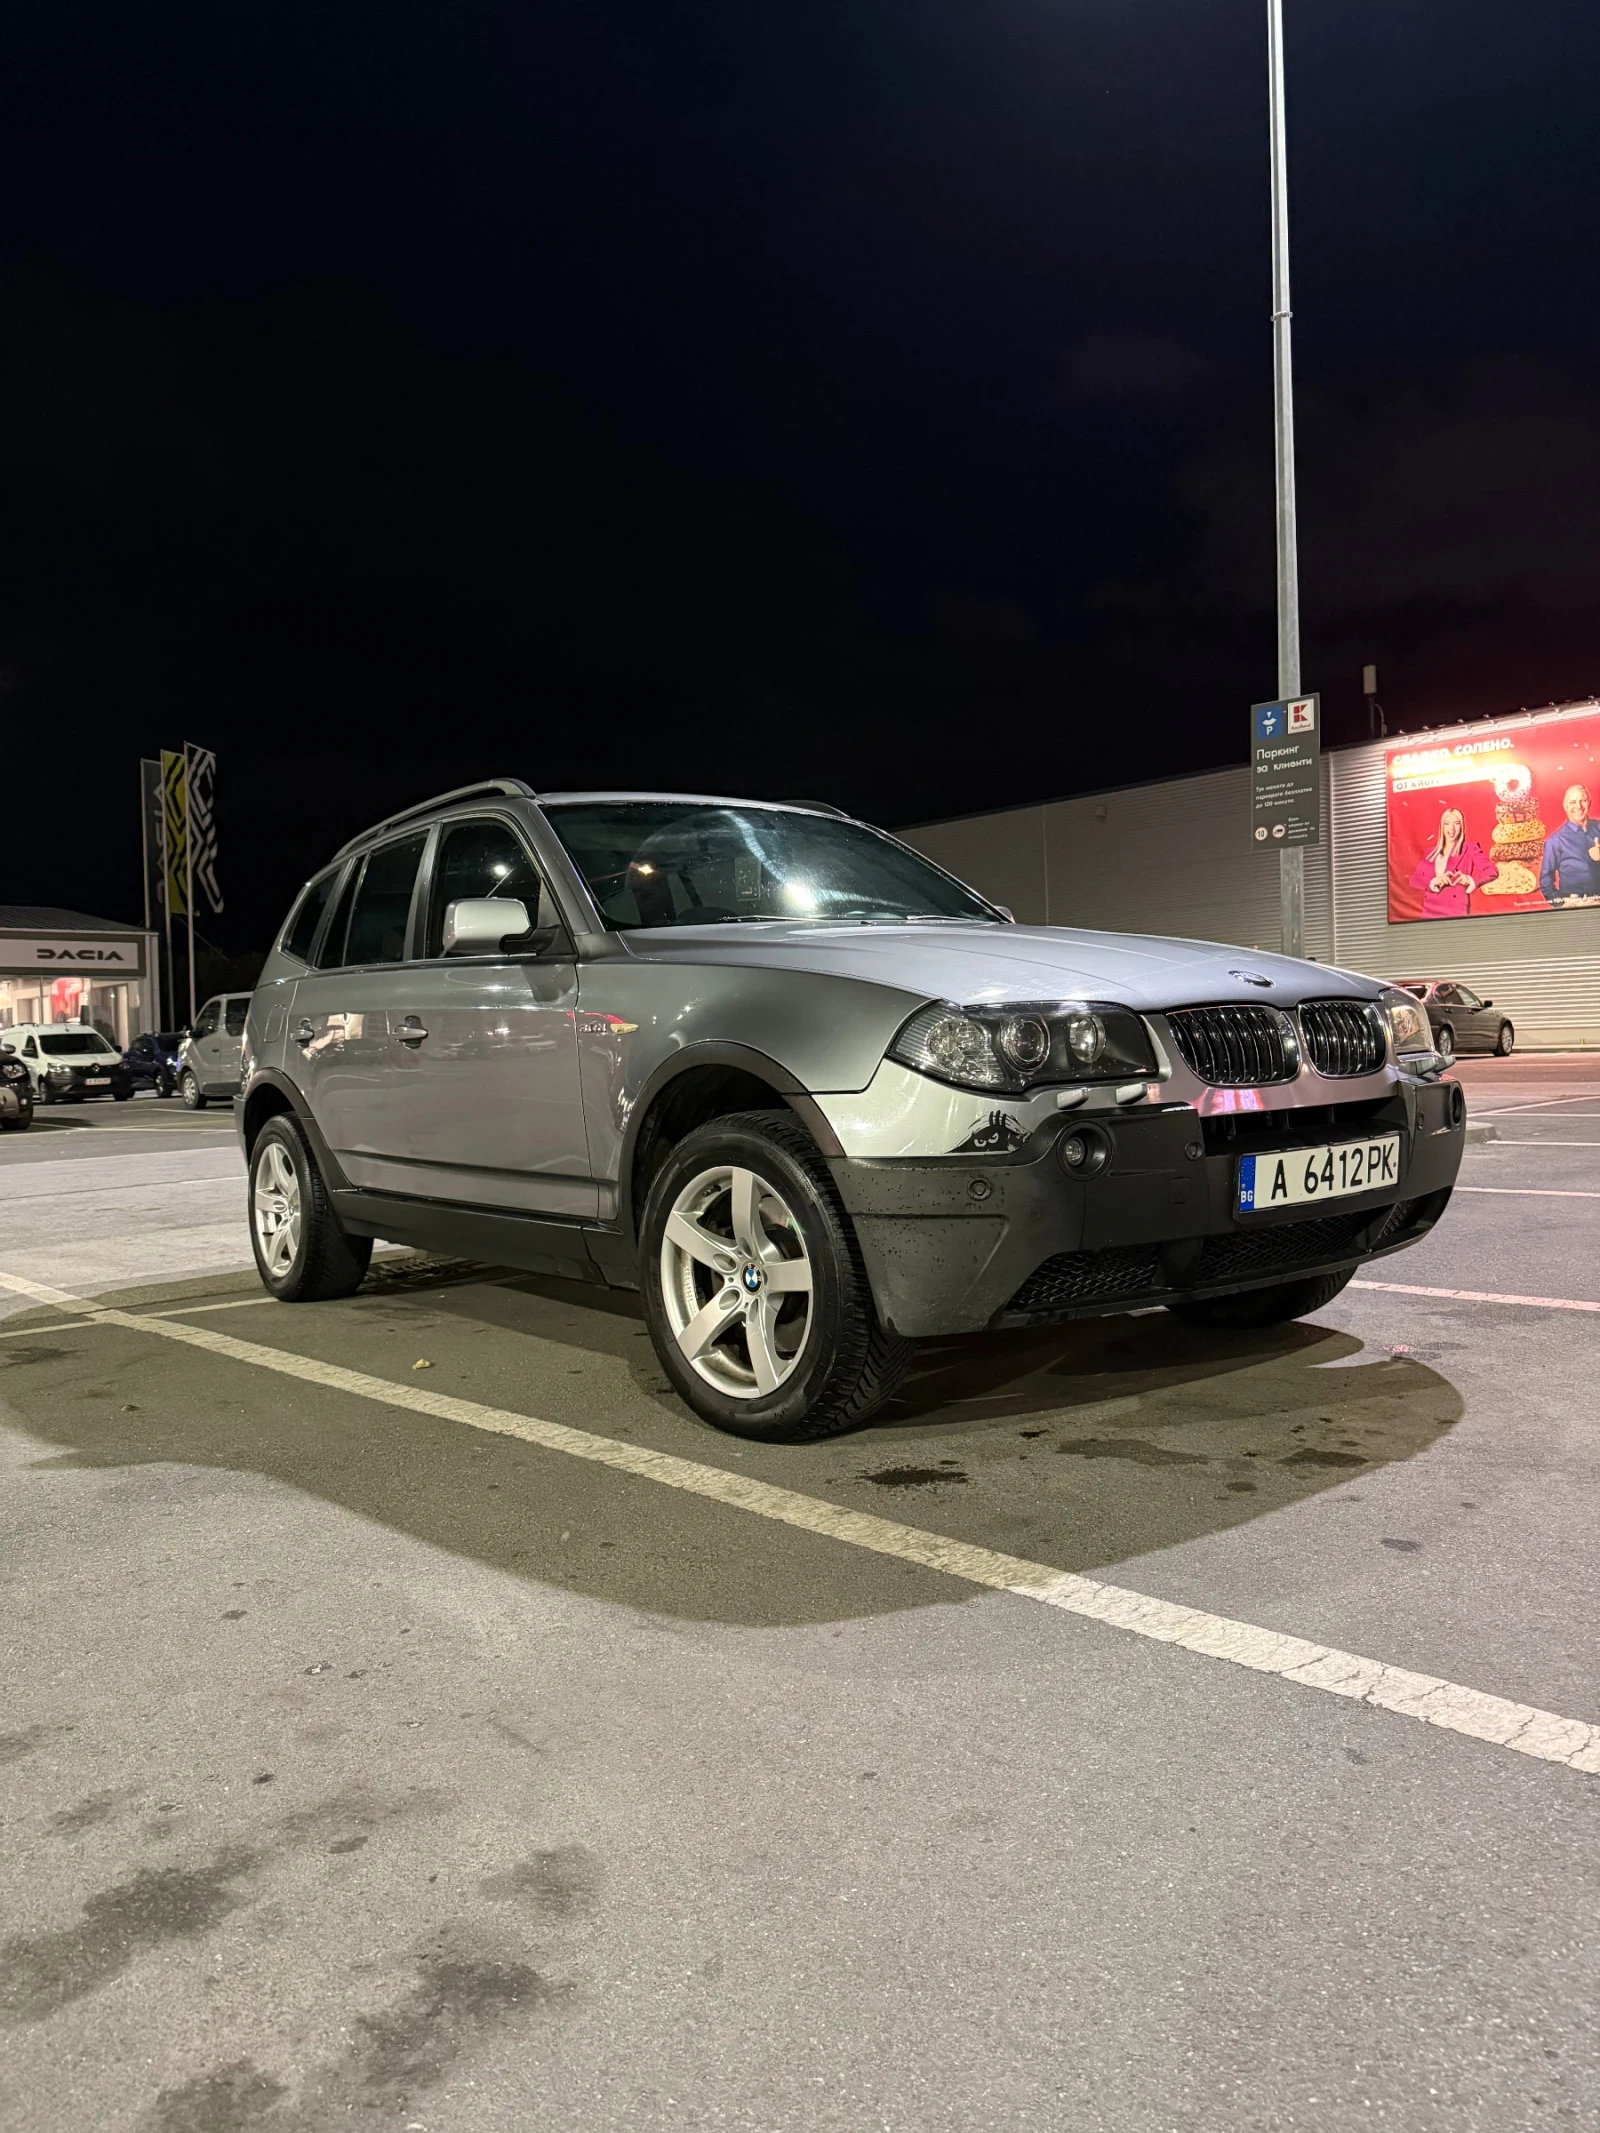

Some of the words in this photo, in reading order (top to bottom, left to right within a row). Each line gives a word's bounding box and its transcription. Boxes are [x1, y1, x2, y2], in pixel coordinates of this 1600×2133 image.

[1266, 726, 1273, 735] P
[1256, 745, 1299, 760] Паркинг
[1454, 738, 1514, 756] СОЛЕНО.
[1256, 765, 1268, 773] за
[1257, 830, 1265, 838] 10
[36, 948, 124, 961] DACIA
[1271, 1159, 1288, 1200] A
[1240, 1190, 1254, 1203] BG
